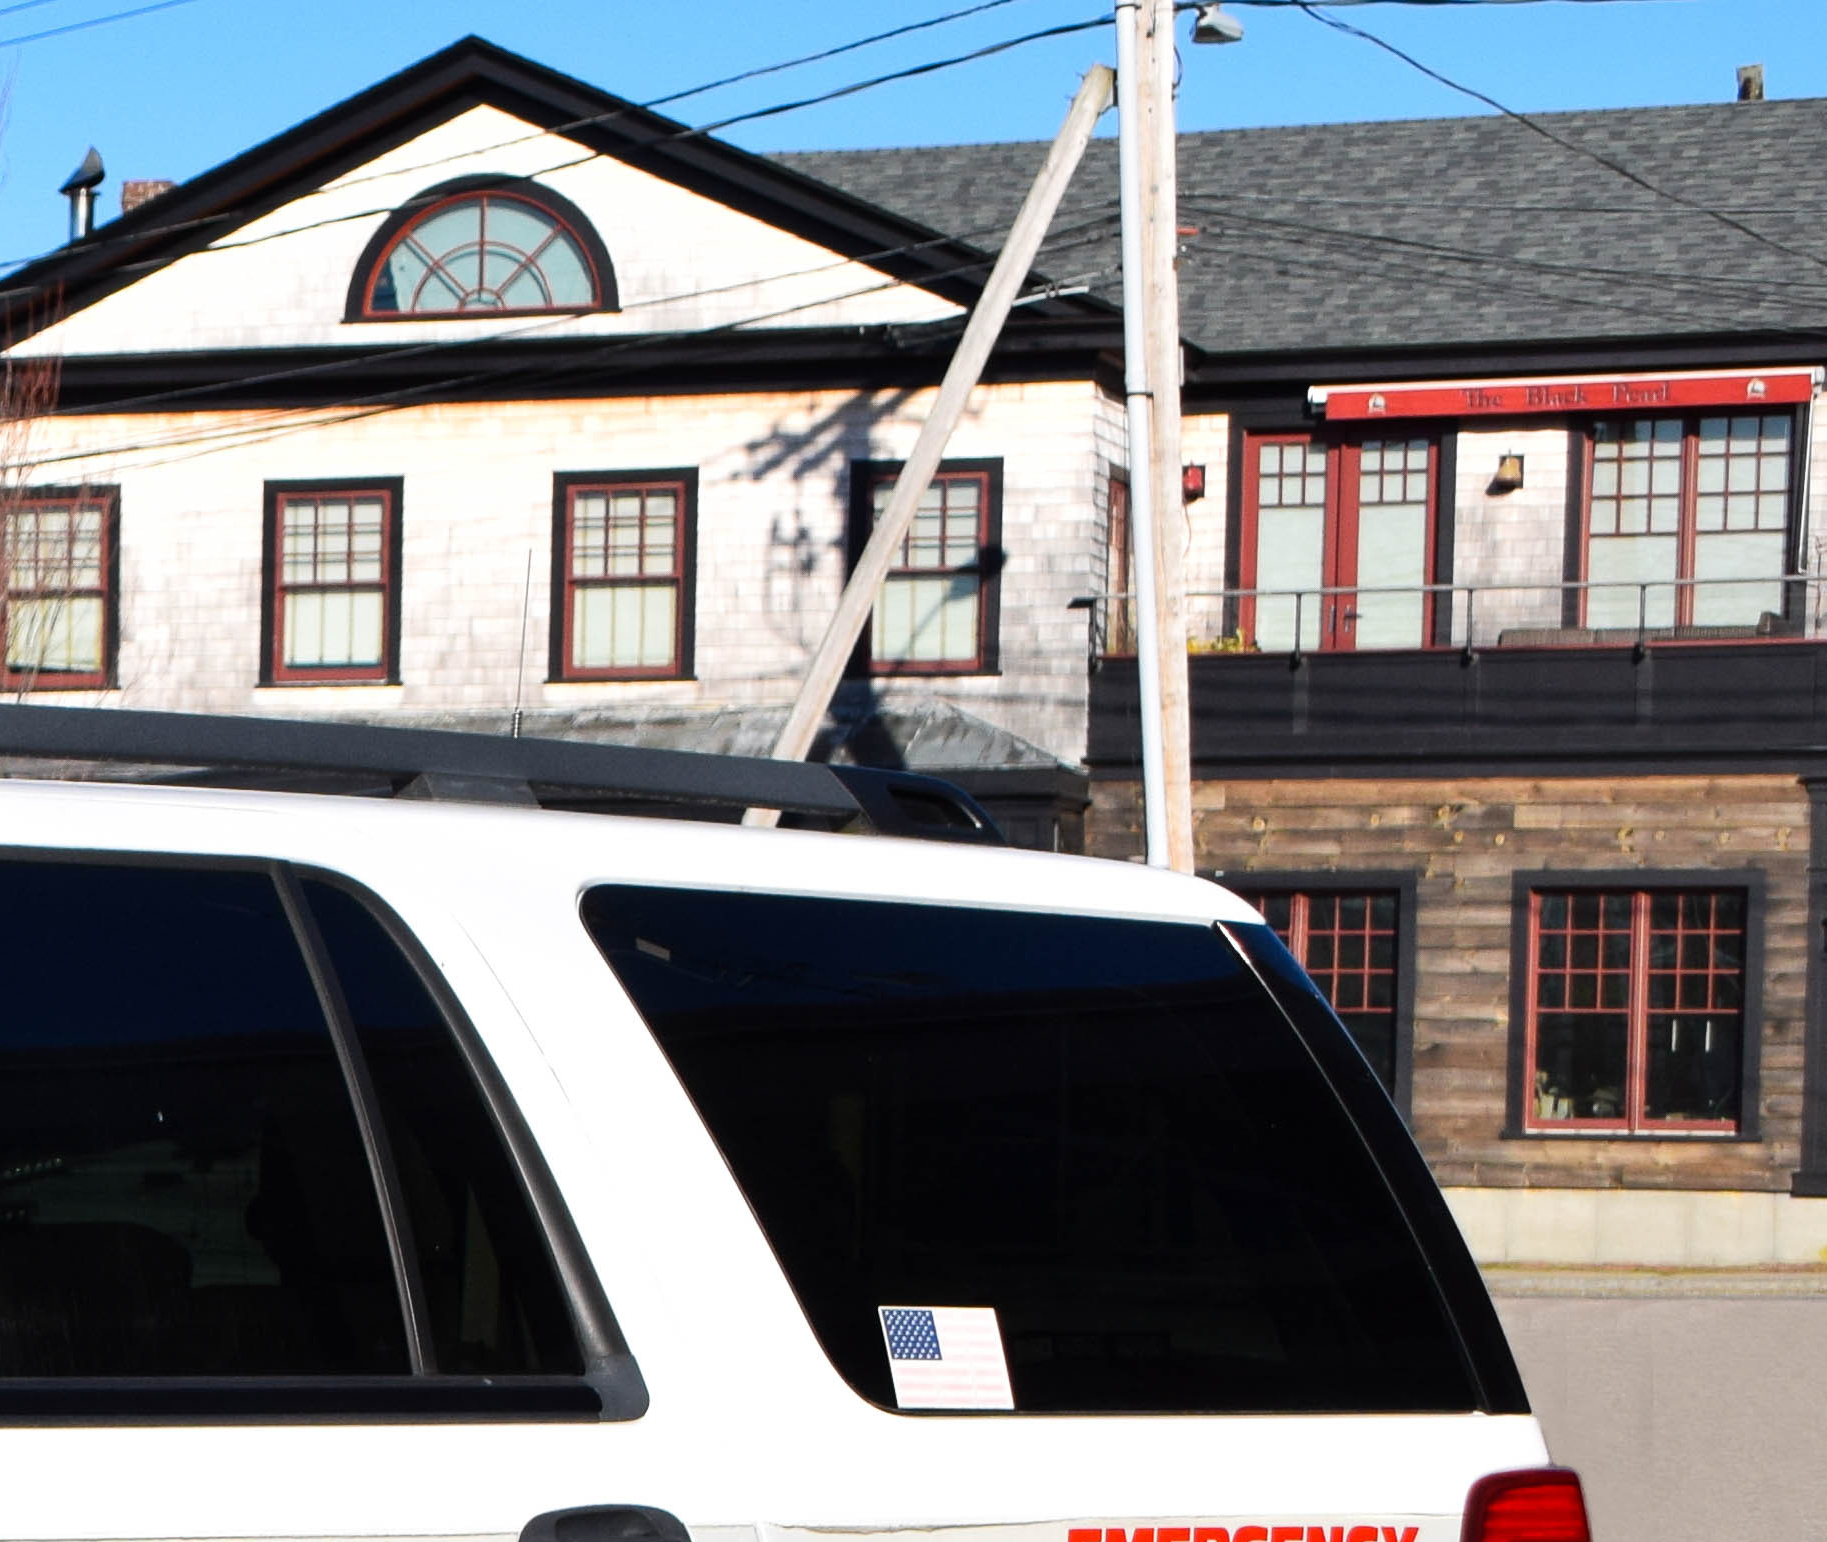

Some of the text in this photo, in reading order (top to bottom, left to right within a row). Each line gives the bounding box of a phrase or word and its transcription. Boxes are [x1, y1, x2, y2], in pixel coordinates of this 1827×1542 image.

[1462, 381, 1670, 408] The Black Pearl
